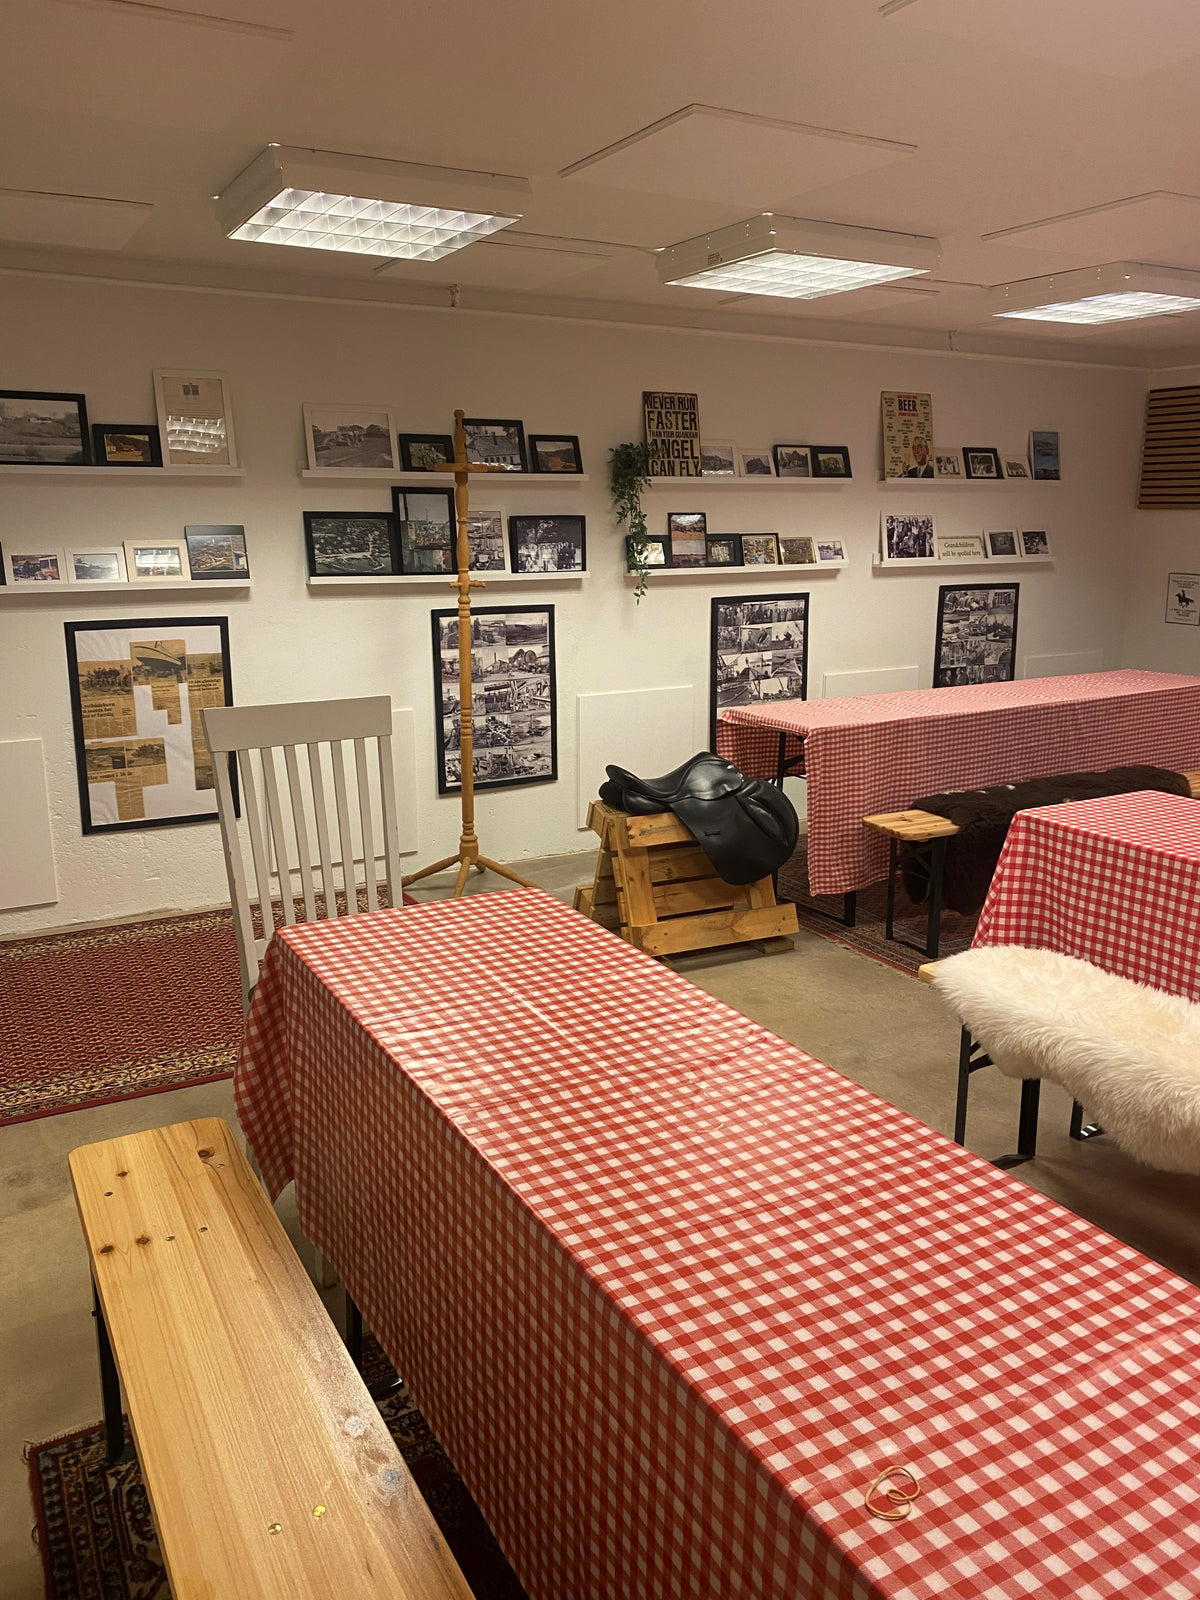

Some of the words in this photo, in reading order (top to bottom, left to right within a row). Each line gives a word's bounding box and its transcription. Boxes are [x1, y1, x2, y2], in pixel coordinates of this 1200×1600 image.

[646, 395, 676, 410] NEVER
[678, 397, 696, 410] RUN
[898, 400, 917, 412] BEER
[648, 410, 697, 430] FASTER
[663, 430, 674, 438] YOUR
[651, 439, 699, 460] ANGEL
[651, 460, 675, 477] CAN
[680, 460, 700, 477] FLY
